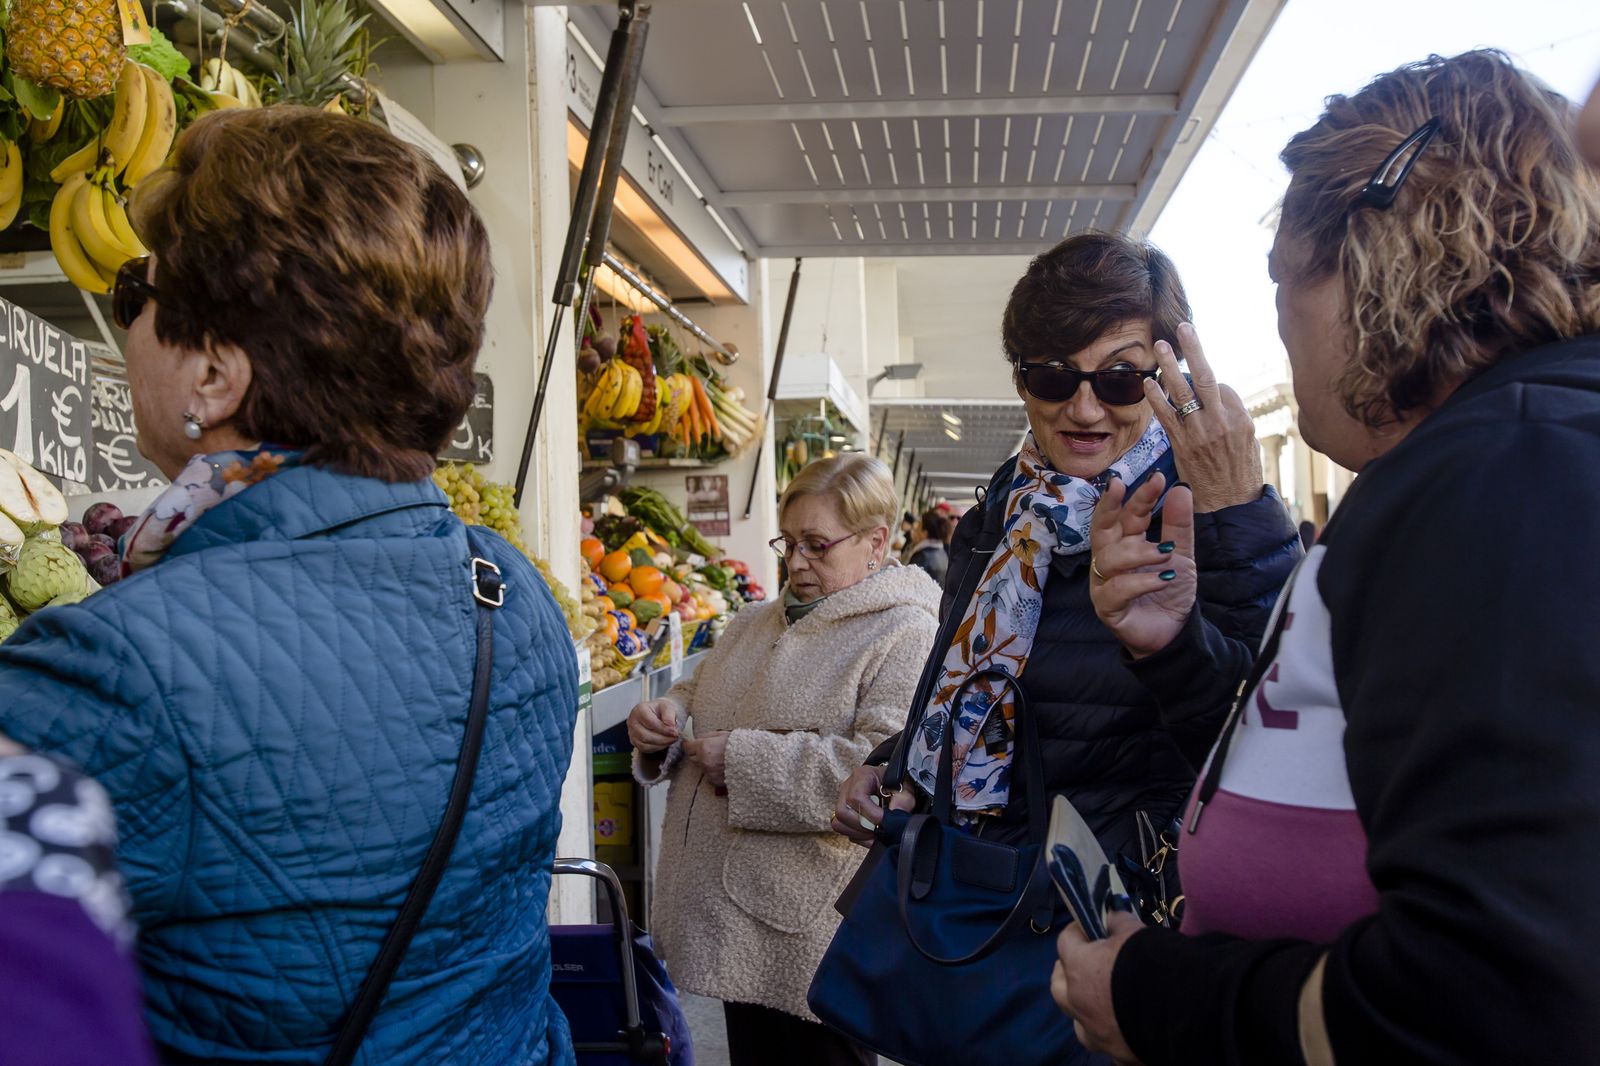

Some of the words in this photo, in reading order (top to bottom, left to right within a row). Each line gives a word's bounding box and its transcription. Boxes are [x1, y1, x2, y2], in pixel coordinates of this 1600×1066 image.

[1, 363, 34, 465] 1
[39, 431, 87, 483] KILO
[551, 962, 585, 973] OLSER
